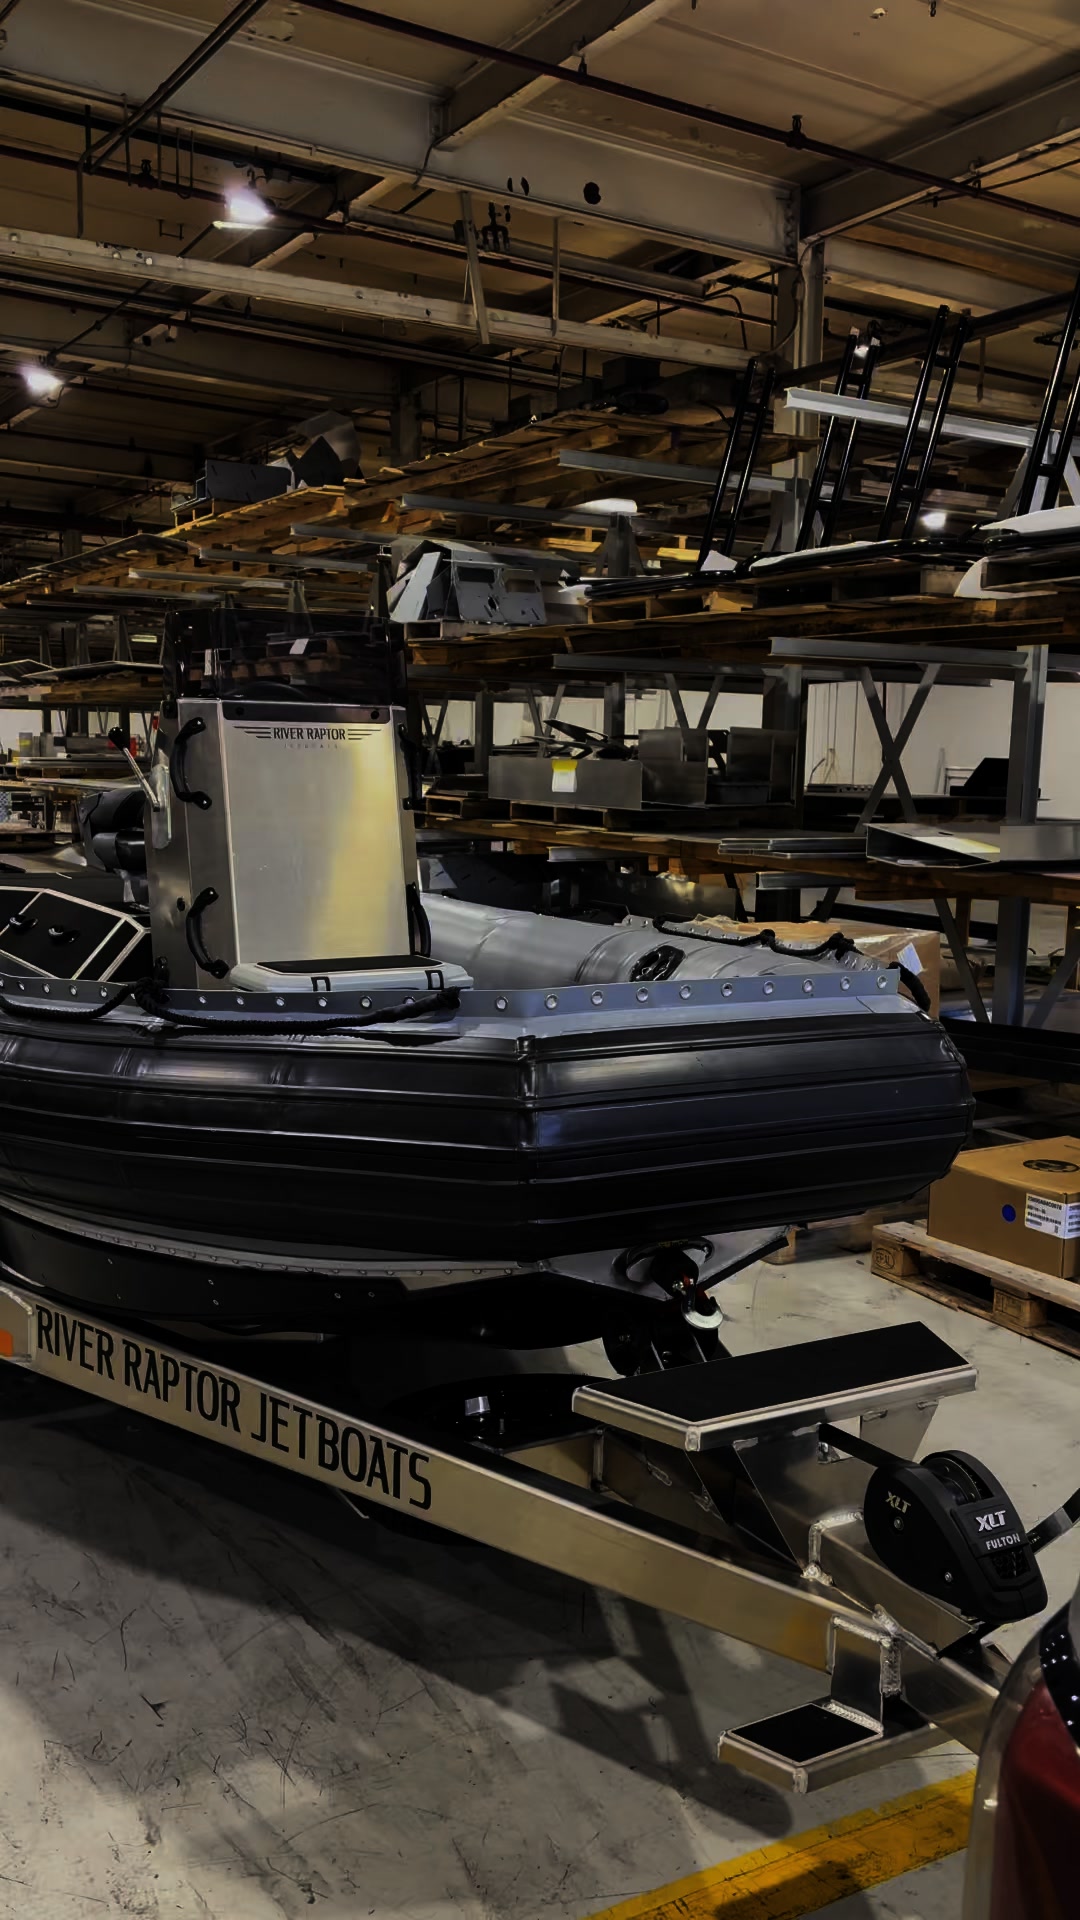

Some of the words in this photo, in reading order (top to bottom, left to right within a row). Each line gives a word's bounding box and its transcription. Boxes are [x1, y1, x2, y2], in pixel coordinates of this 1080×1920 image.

[273, 727, 304, 740] RIVER
[306, 728, 346, 740] RAPTOR
[36, 1304, 115, 1380] RIVER
[122, 1338, 241, 1433] RAPTOR
[250, 1392, 432, 1510] JETBOATS
[885, 1490, 911, 1514] XLT
[975, 1510, 1006, 1532] XLT
[985, 1533, 1020, 1550] FULTON
